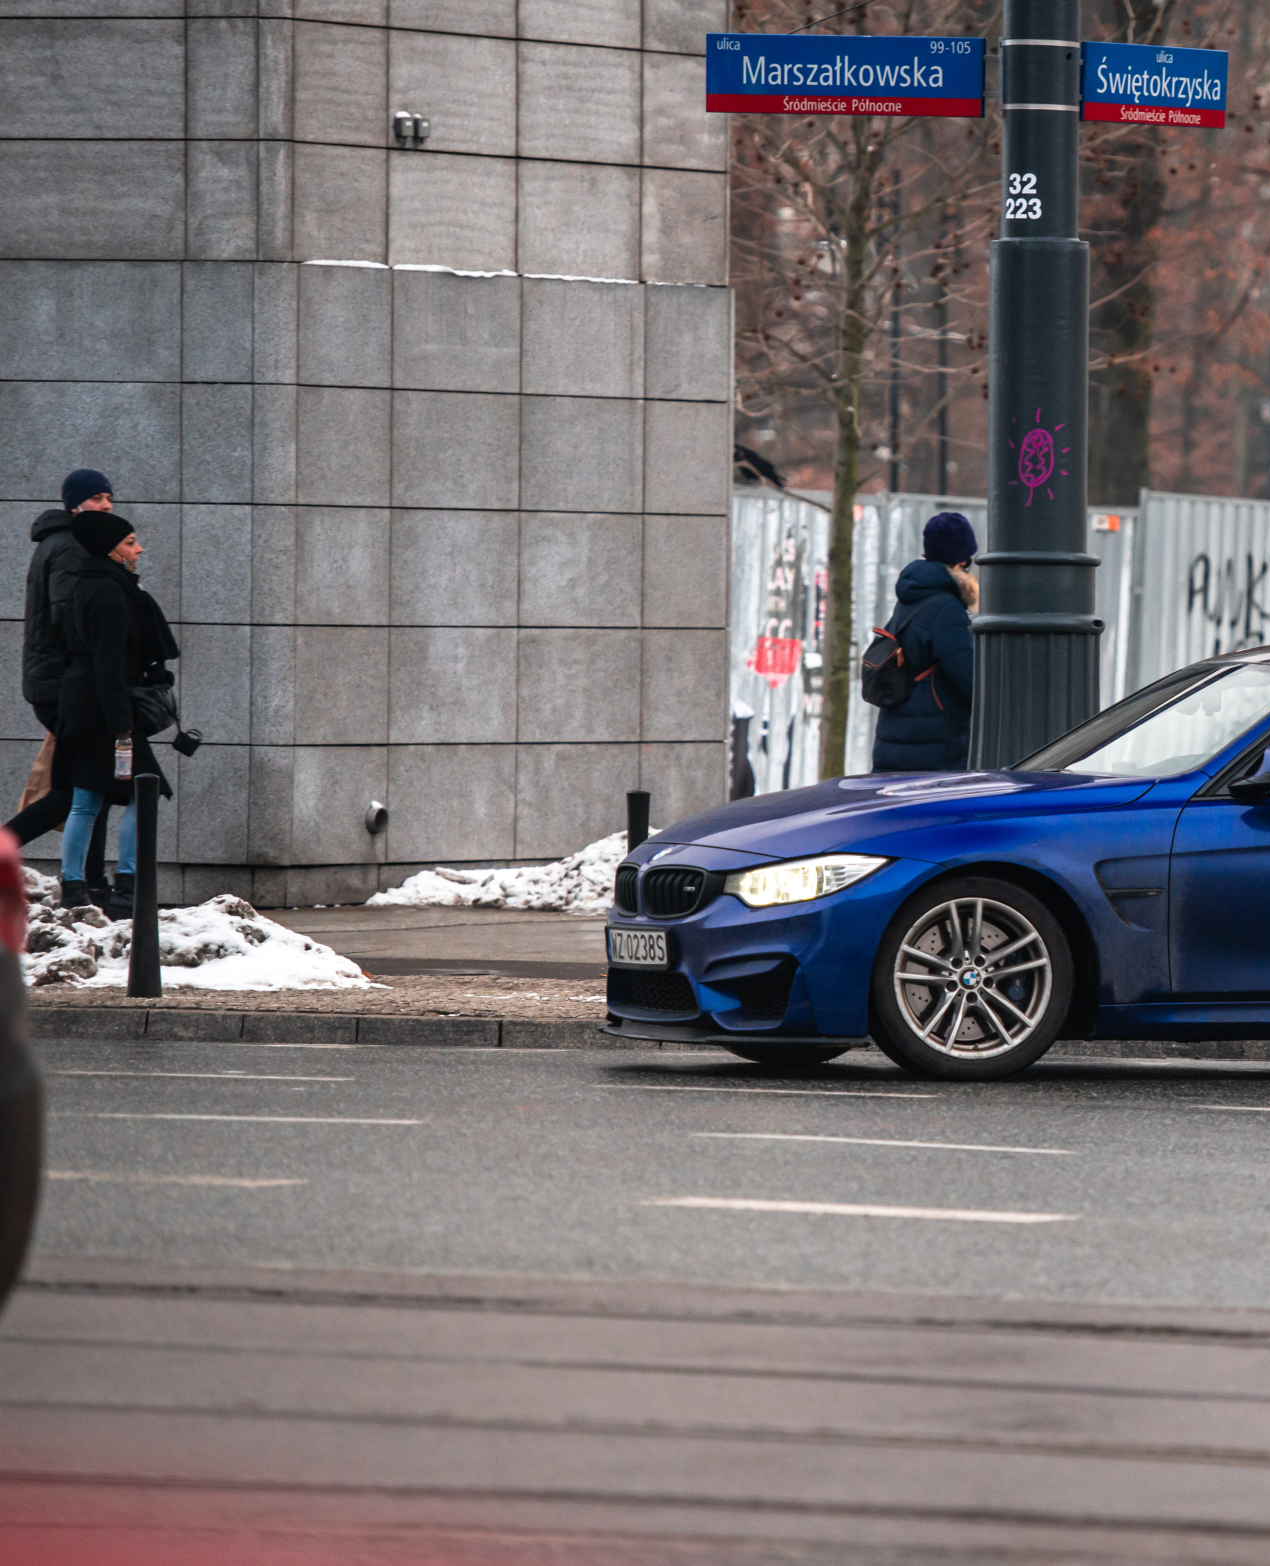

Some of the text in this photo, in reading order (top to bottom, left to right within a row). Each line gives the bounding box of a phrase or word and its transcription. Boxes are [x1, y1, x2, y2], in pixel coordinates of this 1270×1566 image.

[717, 37, 741, 51] ulica
[930, 41, 971, 54] 99-105
[1156, 50, 1173, 64] ulica
[742, 55, 943, 88] Marszałkowska
[1096, 56, 1221, 107] Świętokrzyska
[783, 96, 902, 112] Śródmieście Północne
[1120, 105, 1201, 125] Śródmieście Północne
[1008, 172, 1037, 195] 32
[1005, 197, 1042, 219] 223
[611, 932, 666, 961] WZ 0238S
